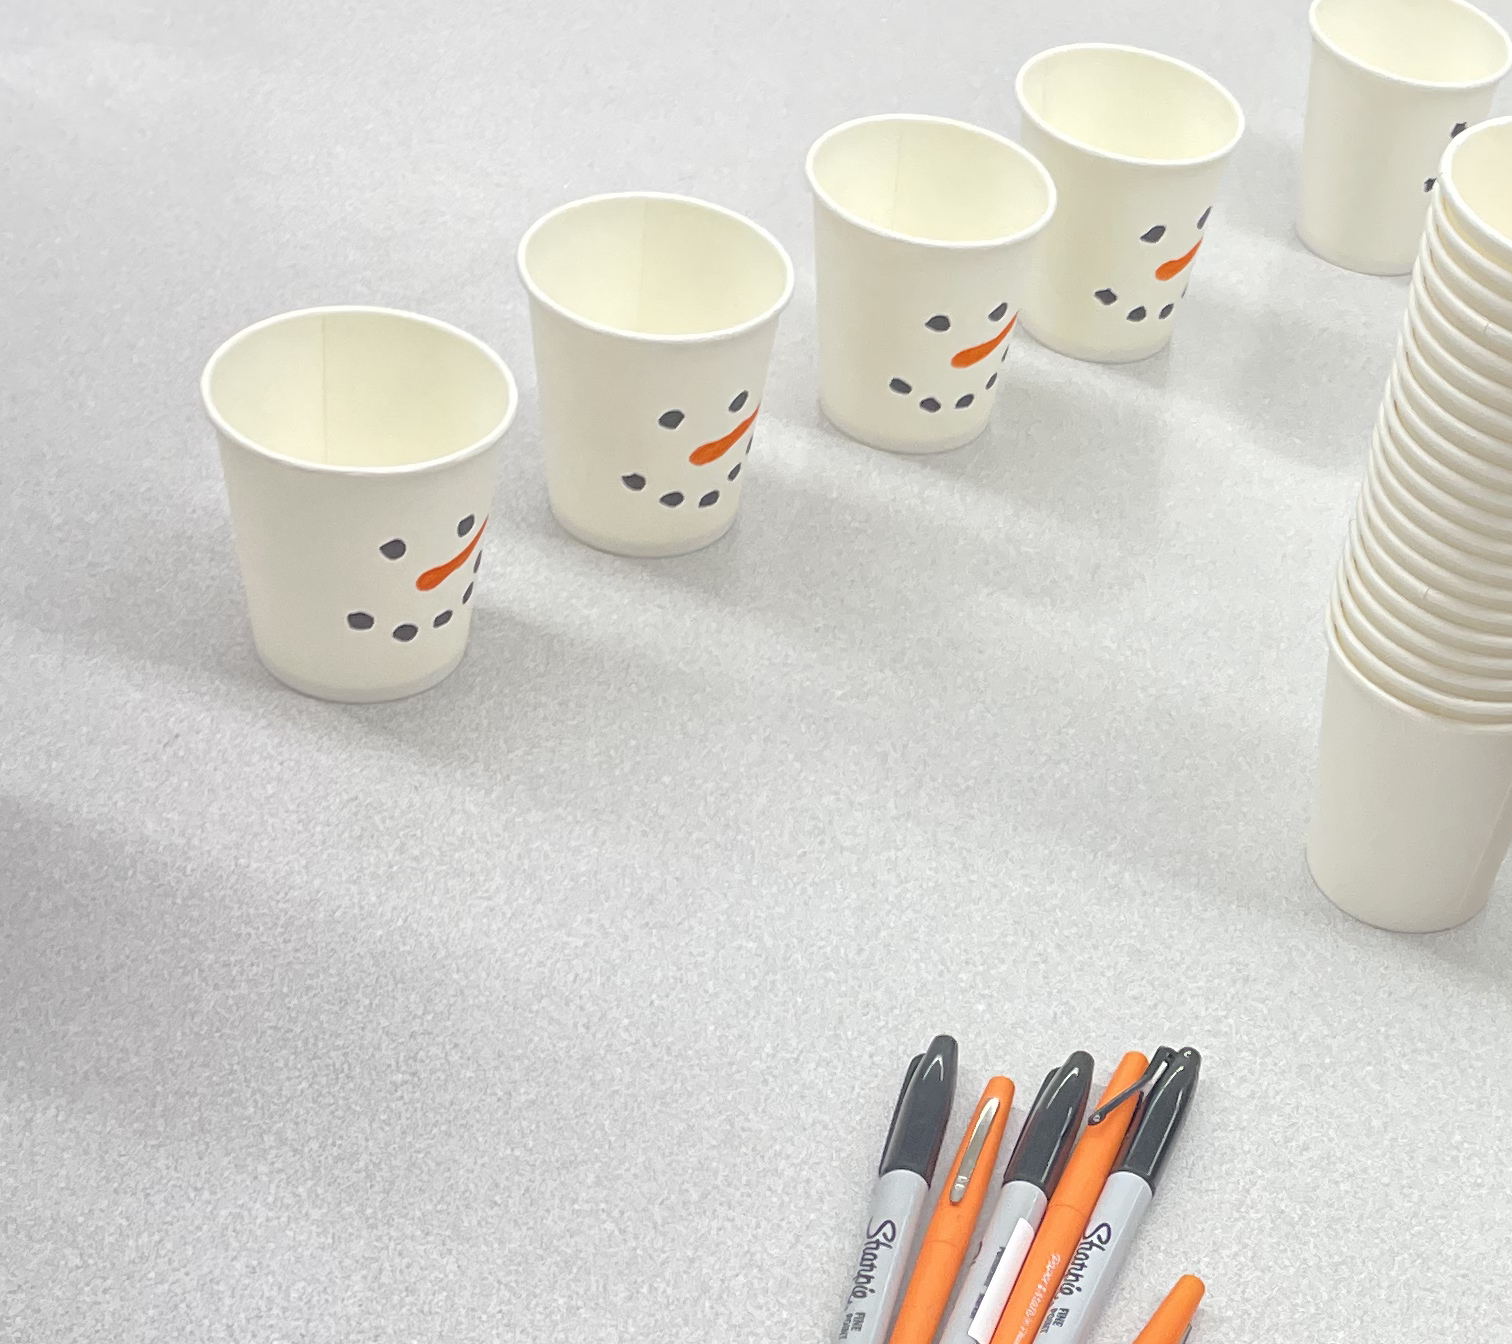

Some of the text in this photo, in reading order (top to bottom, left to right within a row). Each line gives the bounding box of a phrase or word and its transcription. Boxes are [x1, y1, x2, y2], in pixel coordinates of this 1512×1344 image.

[846, 1215, 896, 1306] Sharpie
[851, 1312, 866, 1332] FINE
[1052, 1308, 1070, 1328] FINE
